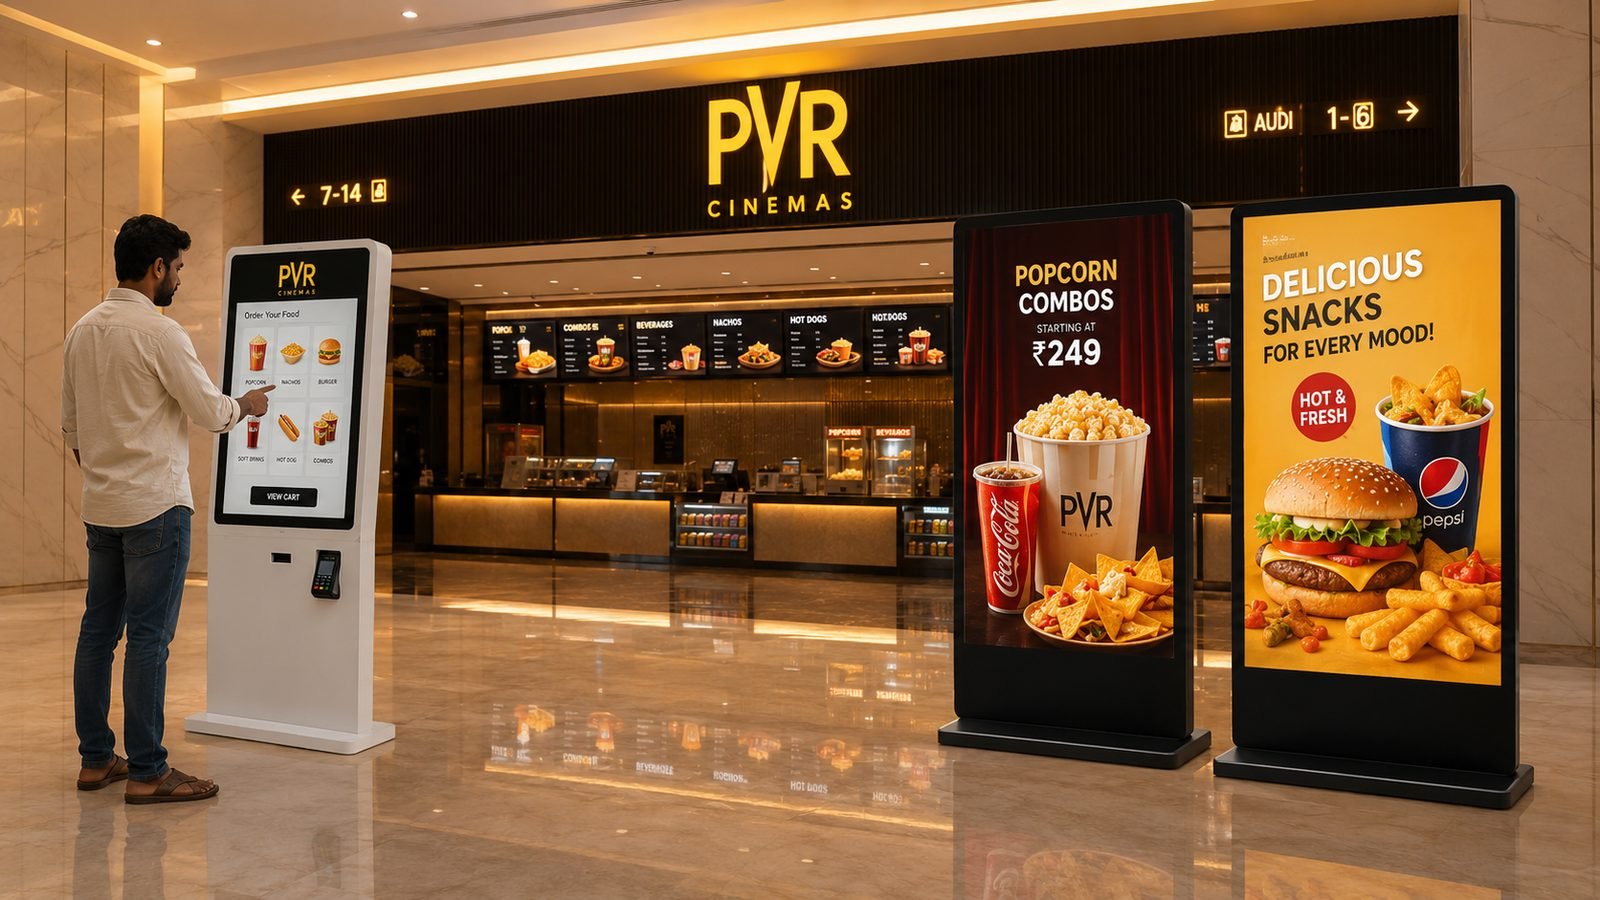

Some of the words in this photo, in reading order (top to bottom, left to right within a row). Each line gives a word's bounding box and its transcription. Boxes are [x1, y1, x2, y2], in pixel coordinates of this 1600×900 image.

[1254, 110, 1294, 132] AUDI
[708, 80, 851, 188] PVR
[320, 182, 362, 206] 7-14
[707, 191, 853, 218] CINEMAS
[278, 261, 316, 289] PVR
[1015, 258, 1118, 287] POPCORN
[1263, 249, 1424, 302] DELICIOUS
[277, 289, 316, 297] CINEMAS
[1018, 288, 1115, 315] COMBOS
[244, 311, 263, 319] Order
[265, 310, 281, 318] Your
[282, 309, 300, 318] Food
[636, 320, 674, 330] BEVERAGES
[713, 318, 743, 327] NACHOS
[790, 316, 805, 324] HOT
[807, 315, 828, 324] DOGS
[1263, 292, 1383, 336] SNACKS
[1036, 322, 1082, 334] STARTING
[1084, 321, 1096, 332] AT
[1032, 338, 1102, 367] ₹249
[1263, 342, 1299, 365] FOR
[1304, 332, 1363, 359] EVERY
[1369, 322, 1435, 350] MOOD!
[1300, 390, 1332, 409] HOT
[1335, 388, 1346, 405] &
[1300, 408, 1348, 427] FRESH
[266, 492, 283, 501] VIEW
[283, 493, 301, 501] CART
[1060, 491, 1113, 532] PVR
[1422, 509, 1465, 530] pepsi
[991, 492, 1020, 598] Coca-Cola
